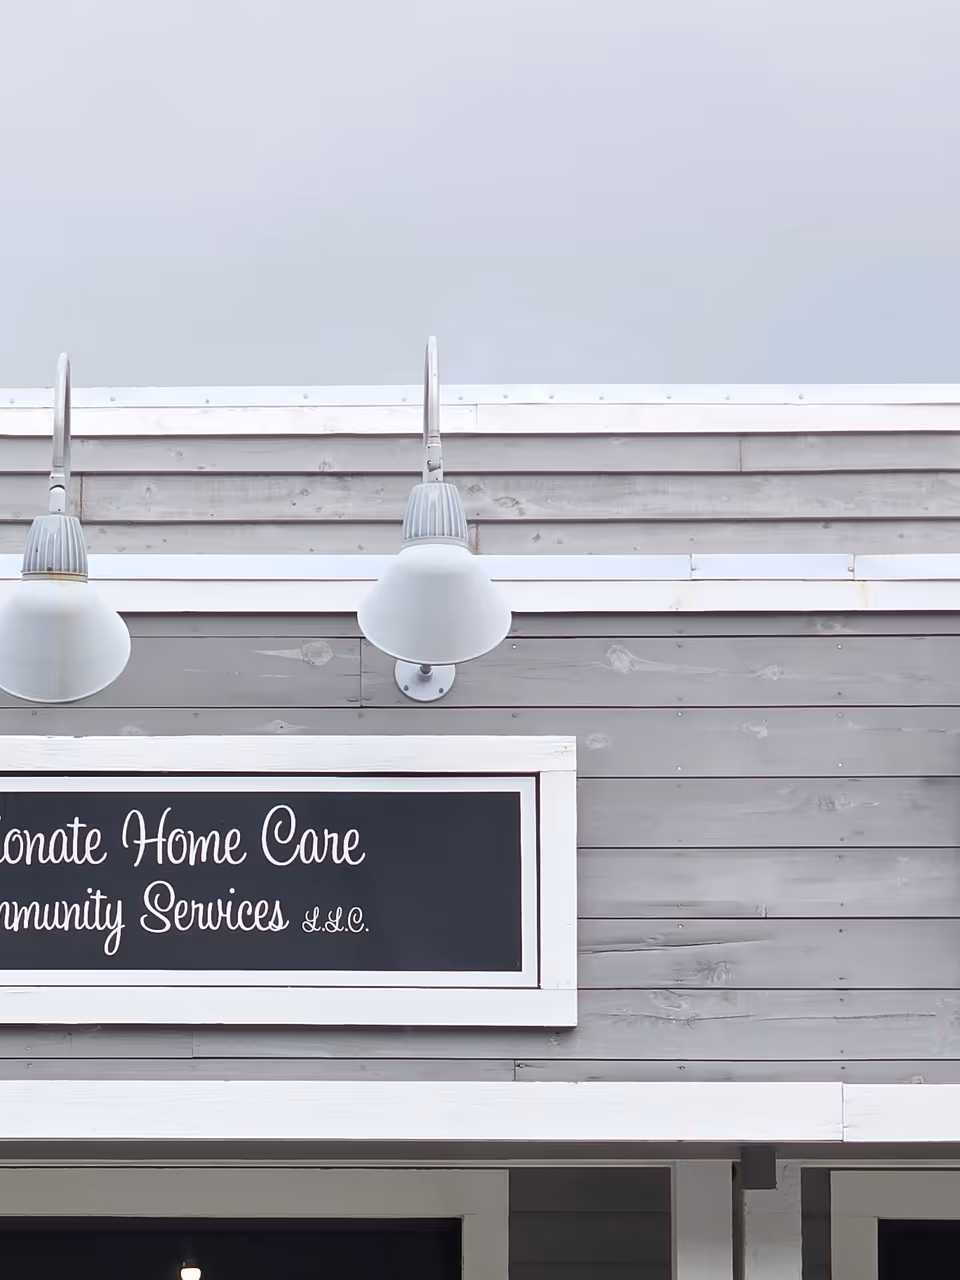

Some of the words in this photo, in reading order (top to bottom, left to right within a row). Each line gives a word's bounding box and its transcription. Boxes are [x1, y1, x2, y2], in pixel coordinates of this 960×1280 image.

[122, 806, 248, 867] Home
[261, 804, 366, 866] Care
[140, 880, 290, 933] Services
